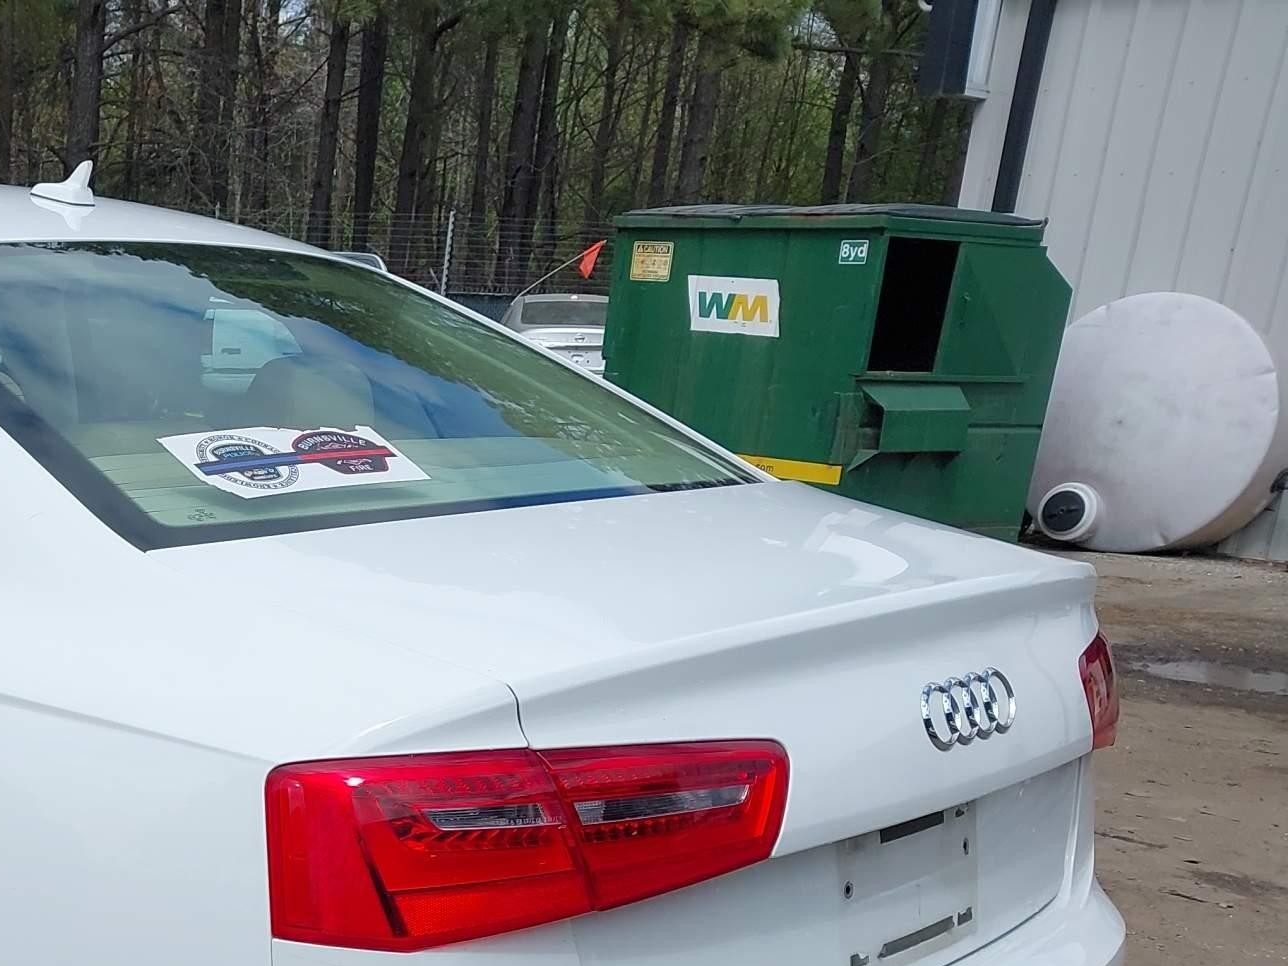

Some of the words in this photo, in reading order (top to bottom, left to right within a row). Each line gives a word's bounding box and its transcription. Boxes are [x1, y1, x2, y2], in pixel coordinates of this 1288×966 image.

[643, 245, 669, 254] CAUTION
[841, 243, 867, 261] 8yd
[698, 291, 769, 323] WM
[297, 434, 367, 450] BURNSVILLE
[349, 463, 374, 473] FIRE
